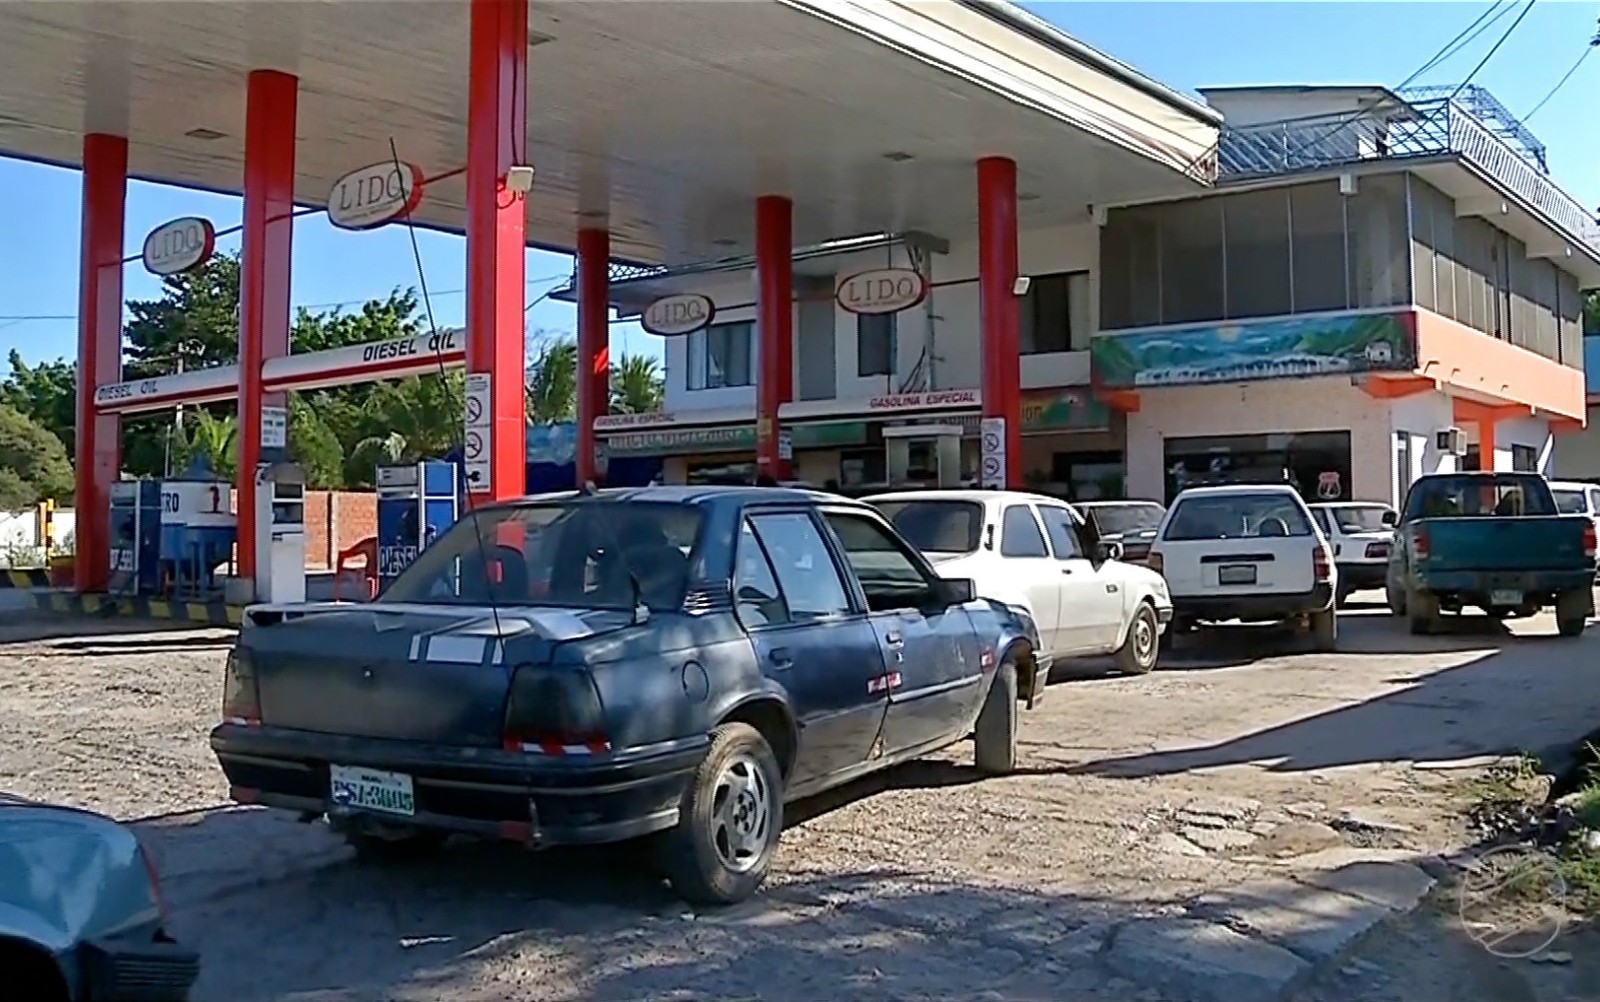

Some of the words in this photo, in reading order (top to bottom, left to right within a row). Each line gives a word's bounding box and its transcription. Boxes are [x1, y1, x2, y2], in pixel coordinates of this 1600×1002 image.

[340, 169, 409, 211] LIDO
[152, 226, 203, 260] LIDO
[849, 277, 915, 302] LIDO
[652, 300, 704, 323] LIDO
[363, 339, 417, 361] DIESEL
[428, 332, 455, 351] OIL
[98, 384, 132, 401] DIESEL
[141, 380, 158, 394] OIL
[870, 393, 920, 408] GASOLINA
[926, 391, 976, 404] ESPECIAL
[597, 417, 634, 427] GASOLINA
